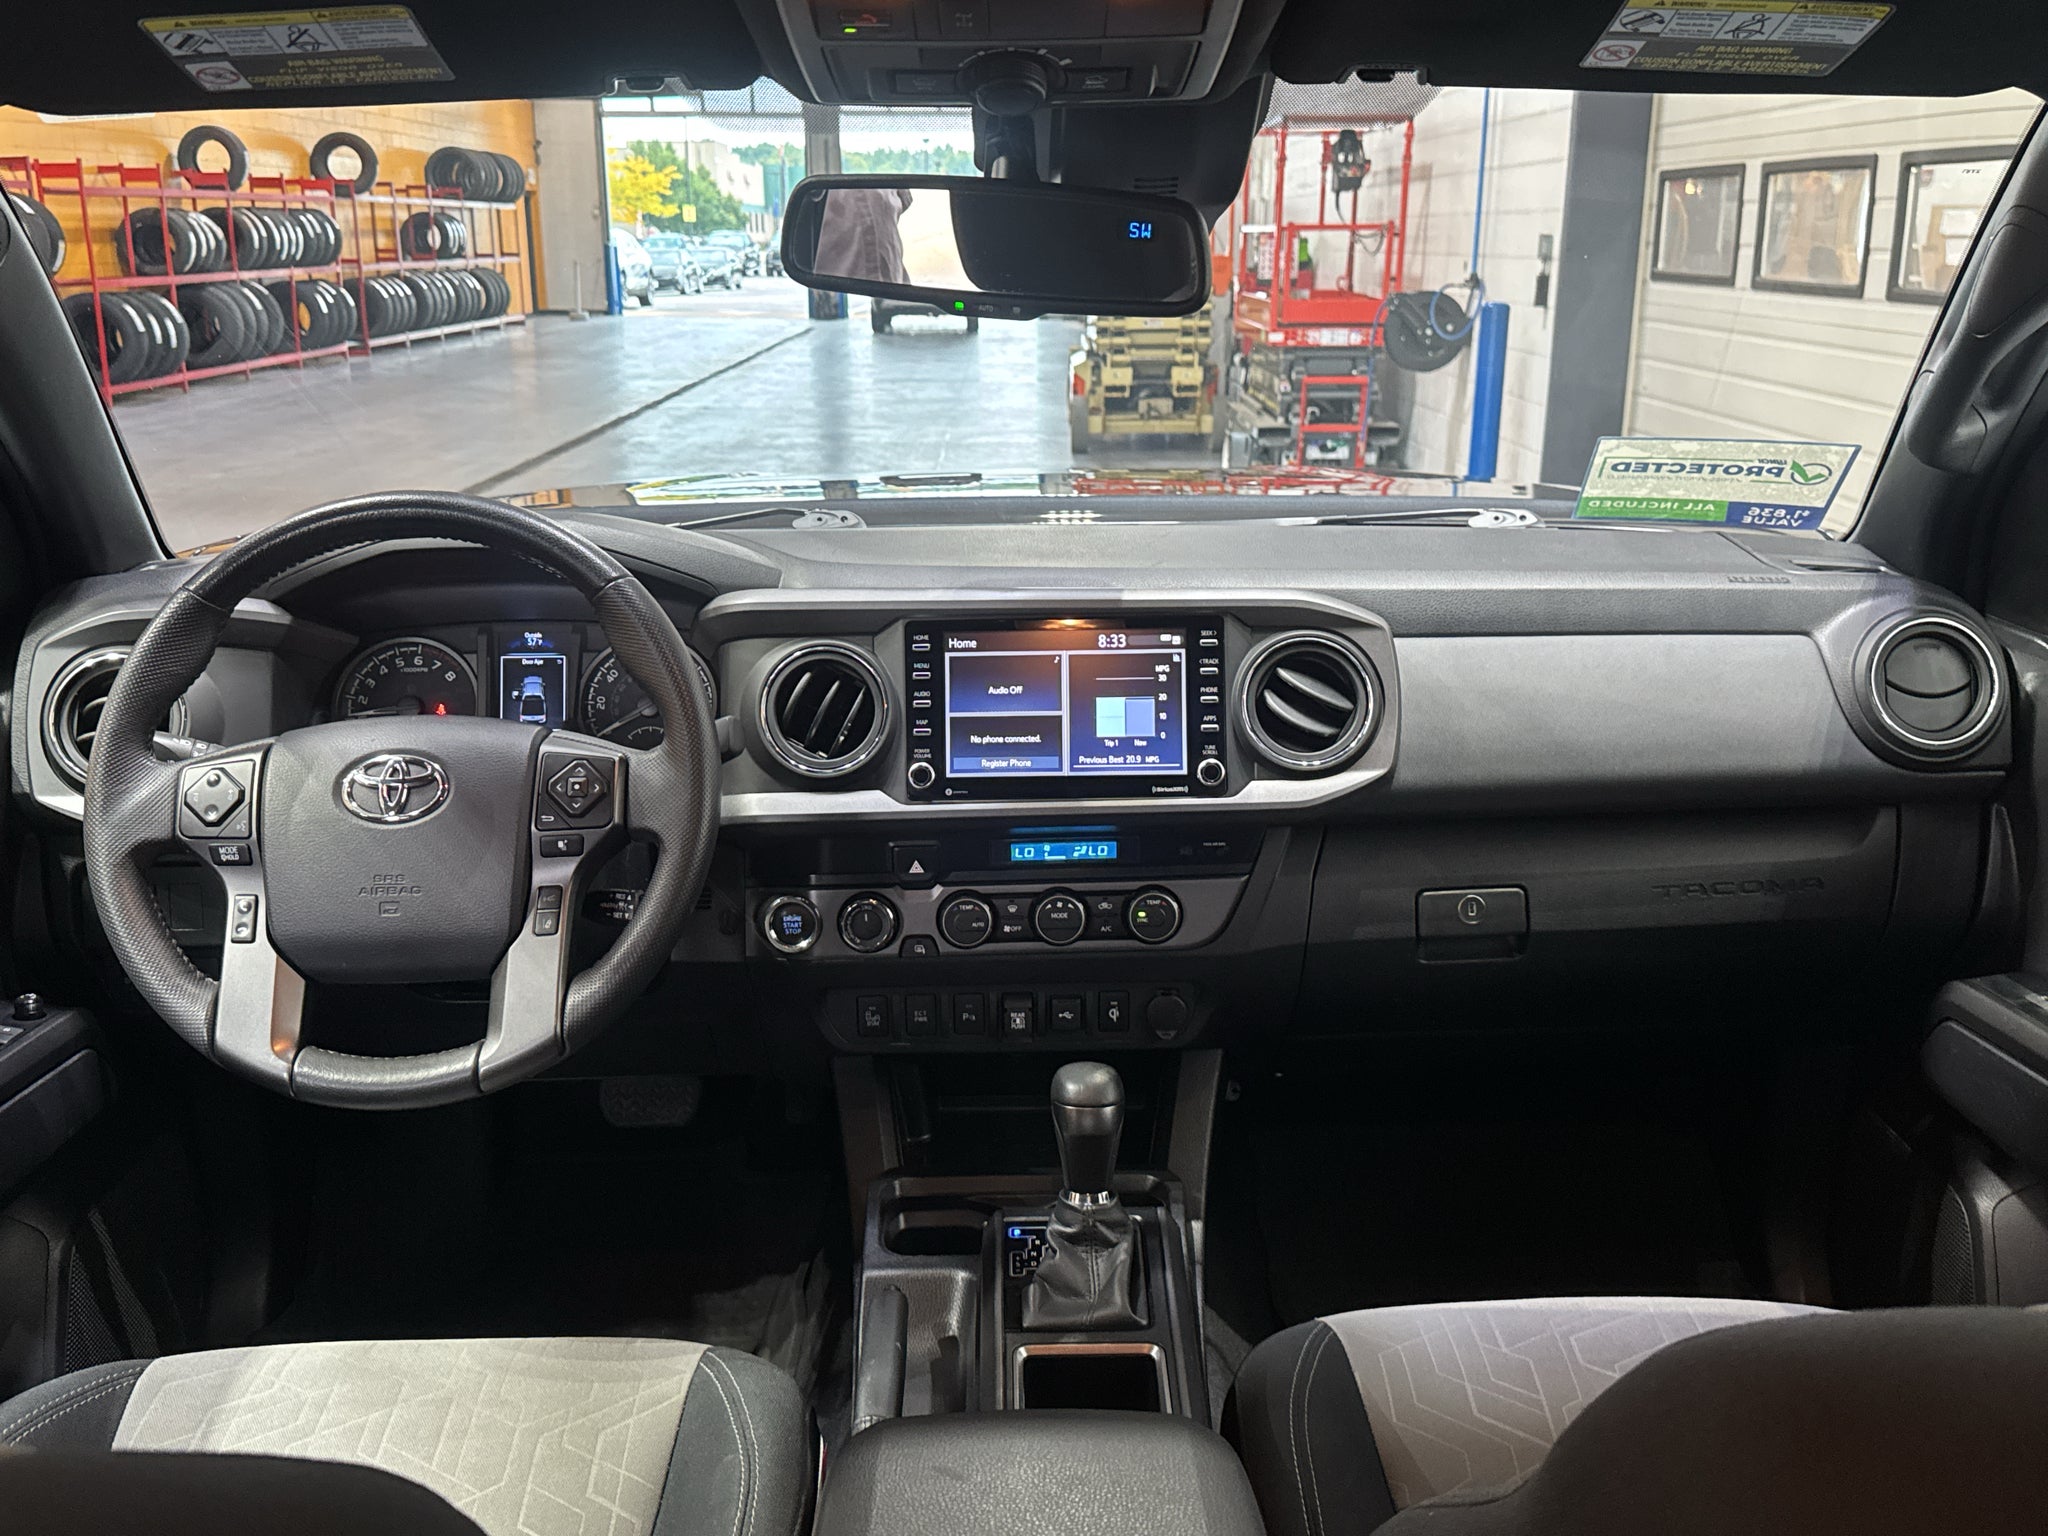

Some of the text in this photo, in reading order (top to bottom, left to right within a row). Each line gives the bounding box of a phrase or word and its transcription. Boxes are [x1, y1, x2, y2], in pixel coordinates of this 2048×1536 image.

[1128, 222, 1152, 239] SW
[948, 638, 977, 649] Home
[1098, 634, 1126, 648] 8:33
[395, 657, 405, 668] 5
[414, 655, 424, 666] 6
[431, 659, 442, 670] 7
[379, 665, 389, 676] 4
[1155, 664, 1170, 673] MPG
[444, 671, 457, 682] 8
[606, 669, 619, 683] 40
[1158, 674, 1167, 682] 30
[365, 679, 376, 689] 3
[988, 685, 1023, 695] Audio Off
[1158, 693, 1167, 701] 20
[596, 696, 606, 710] 20
[1159, 712, 1167, 720] 10
[970, 734, 1042, 744] No phone connected.
[1160, 731, 1166, 739] 0
[1104, 739, 1115, 748] Trip
[981, 759, 1032, 769] Register Phone
[1078, 755, 1160, 764] Previous Best 20.9 MPG
[218, 846, 239, 854] MODE
[1015, 847, 1034, 859] LO
[1088, 845, 1108, 857] LO
[372, 874, 406, 884] SRS
[358, 885, 423, 896] AIRBAG
[1651, 876, 1826, 899] TACOMA
